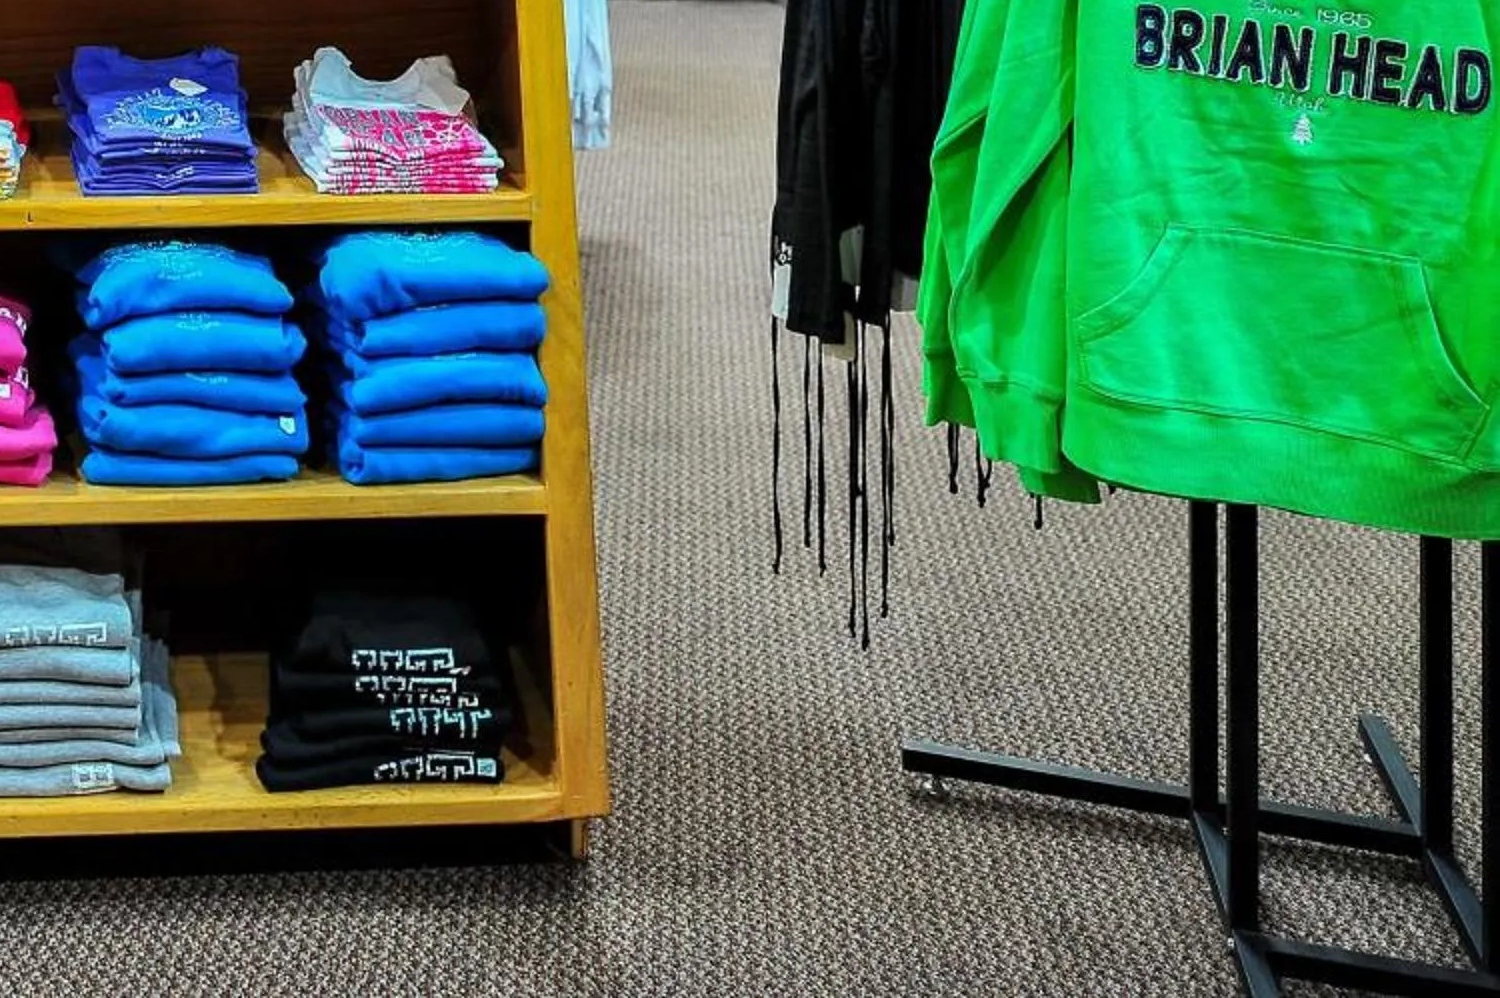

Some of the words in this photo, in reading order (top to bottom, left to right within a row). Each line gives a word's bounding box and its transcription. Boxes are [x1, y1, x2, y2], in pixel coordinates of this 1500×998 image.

[1317, 8, 1373, 30] 1965
[1134, 2, 1316, 92] BRIAN
[1326, 30, 1493, 116] HEAD
